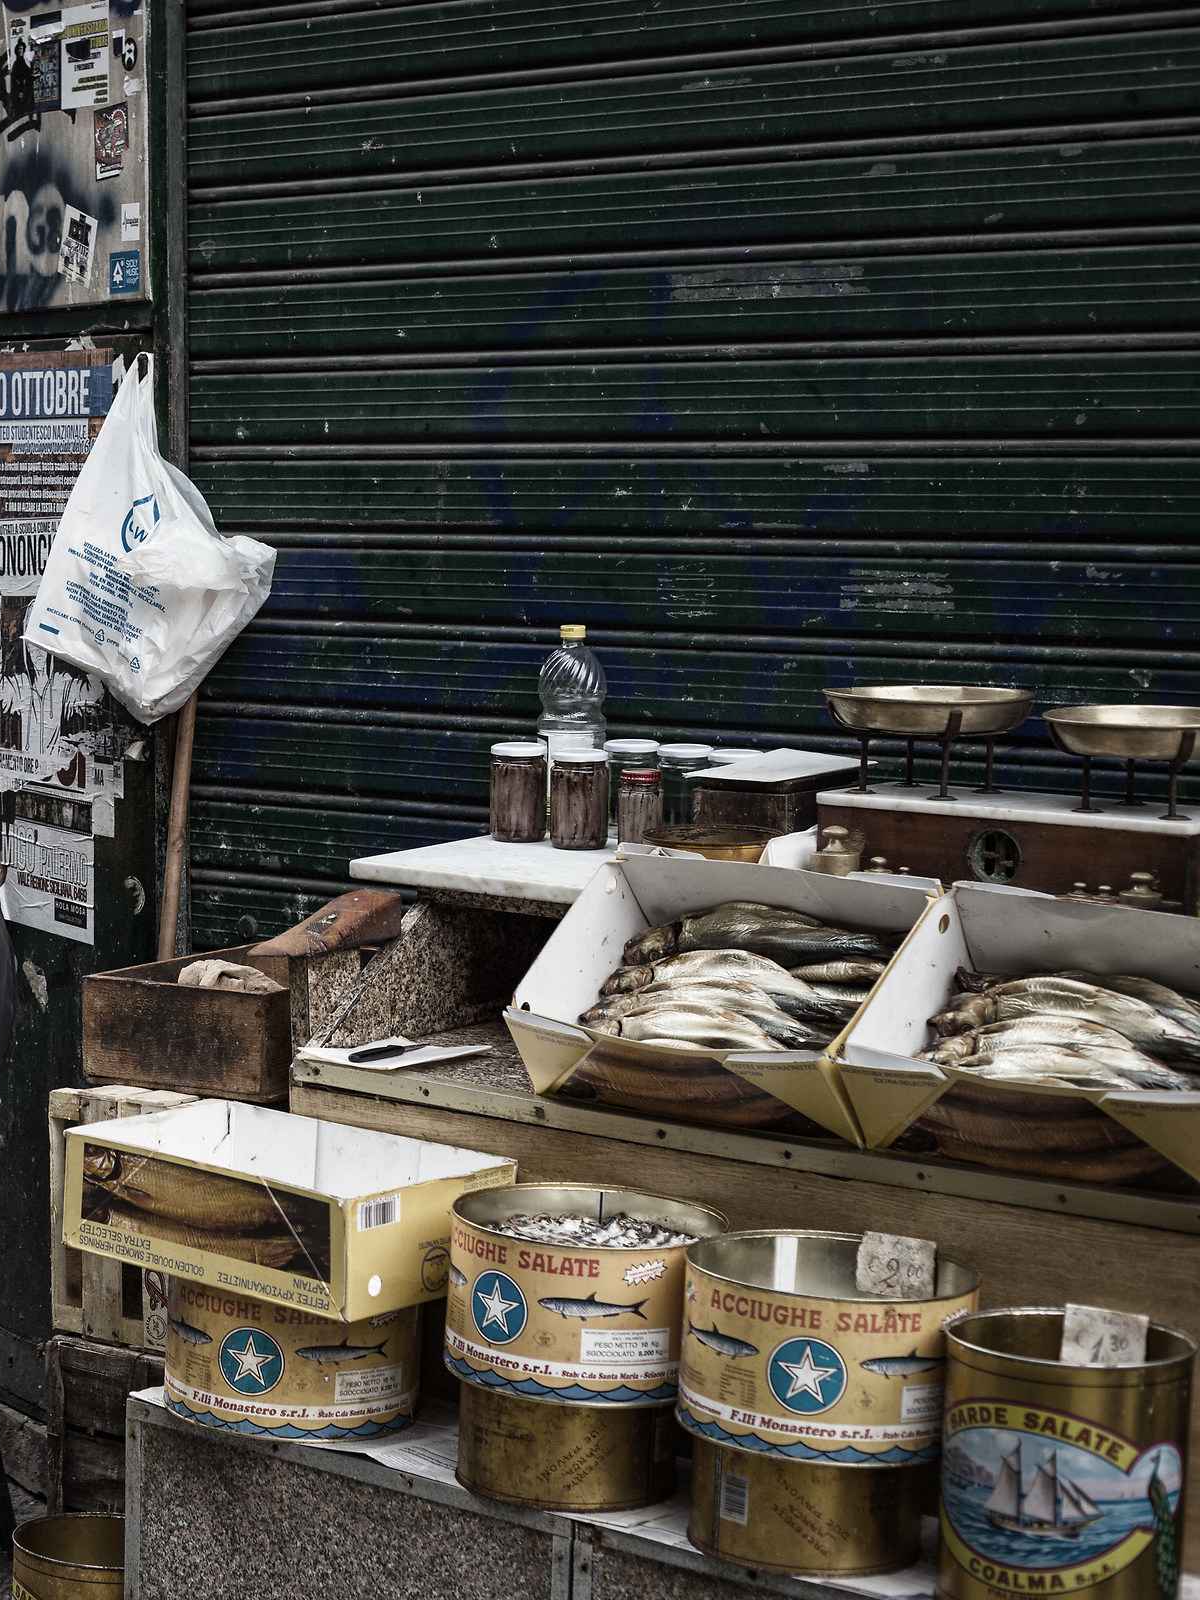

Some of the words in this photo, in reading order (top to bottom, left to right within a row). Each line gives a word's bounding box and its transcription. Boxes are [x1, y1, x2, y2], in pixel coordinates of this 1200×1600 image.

[11, 369, 90, 416] OTTOBRE
[11, 424, 51, 441] STUDENTESCO
[53, 423, 87, 441] NAZIONALE
[37, 522, 51, 534] COME
[24, 755, 35, 774] ORE
[40, 845, 89, 888] PALERMO
[80, 1223, 122, 1242] SELECTED
[124, 1234, 151, 1250] EXTRA
[80, 1235, 114, 1252] HERRINGS
[116, 1245, 144, 1261] SMOKED
[454, 1226, 507, 1265] CCIUGHE
[518, 1250, 600, 1278] SALATE
[146, 1253, 174, 1269] DOUBLE
[175, 1260, 205, 1276] GOLDEN
[293, 1278, 331, 1297] CAPTAIN
[180, 1285, 262, 1321] ACCIUGHE
[711, 1289, 822, 1330] ACCIUGHE
[837, 1312, 922, 1334] SALATE
[452, 1336, 465, 1353] F.lli
[466, 1343, 519, 1370] Monastero
[522, 1363, 552, 1376] s.r.l.
[582, 1371, 596, 1379] C.da
[598, 1372, 618, 1380] Santa
[620, 1371, 639, 1380] Maria
[339, 1387, 378, 1397] SGOCCIOLATO
[362, 1378, 381, 1387] NETTO
[192, 1389, 212, 1408] F.lli
[214, 1397, 277, 1417] Monastero
[280, 1407, 310, 1419] s.r.l.
[349, 1409, 365, 1417] Santa
[366, 1405, 381, 1414] Maria
[730, 1409, 756, 1426] F.lli
[759, 1418, 837, 1438] Monastero
[840, 1427, 873, 1440] s.r.l.
[950, 1407, 1009, 1432] SARDE
[1024, 1412, 1125, 1464] SALATE
[826, 1519, 851, 1541] DUE
[968, 1557, 1066, 1591] COALMA
